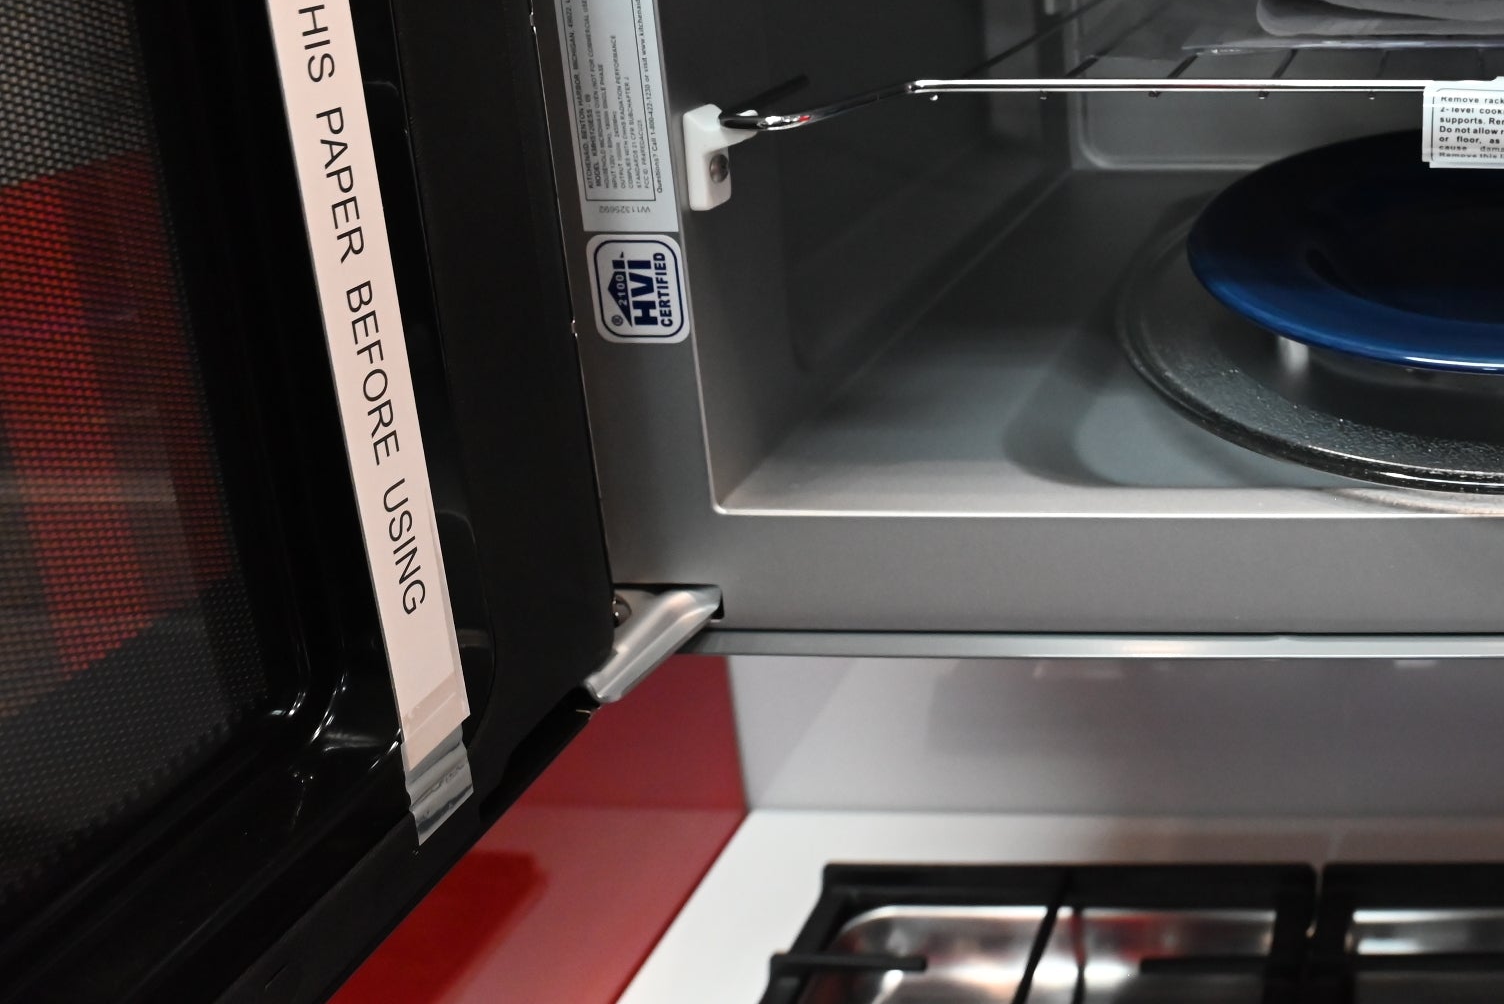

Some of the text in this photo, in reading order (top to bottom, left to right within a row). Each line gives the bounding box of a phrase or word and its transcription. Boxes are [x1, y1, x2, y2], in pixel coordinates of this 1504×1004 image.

[616, 274, 628, 306] 2100
[626, 259, 659, 326] HVI
[652, 252, 674, 328] CERTIFIED
[315, 106, 365, 263] PAPER
[346, 280, 400, 466] BEFORE
[382, 478, 426, 615] USING
